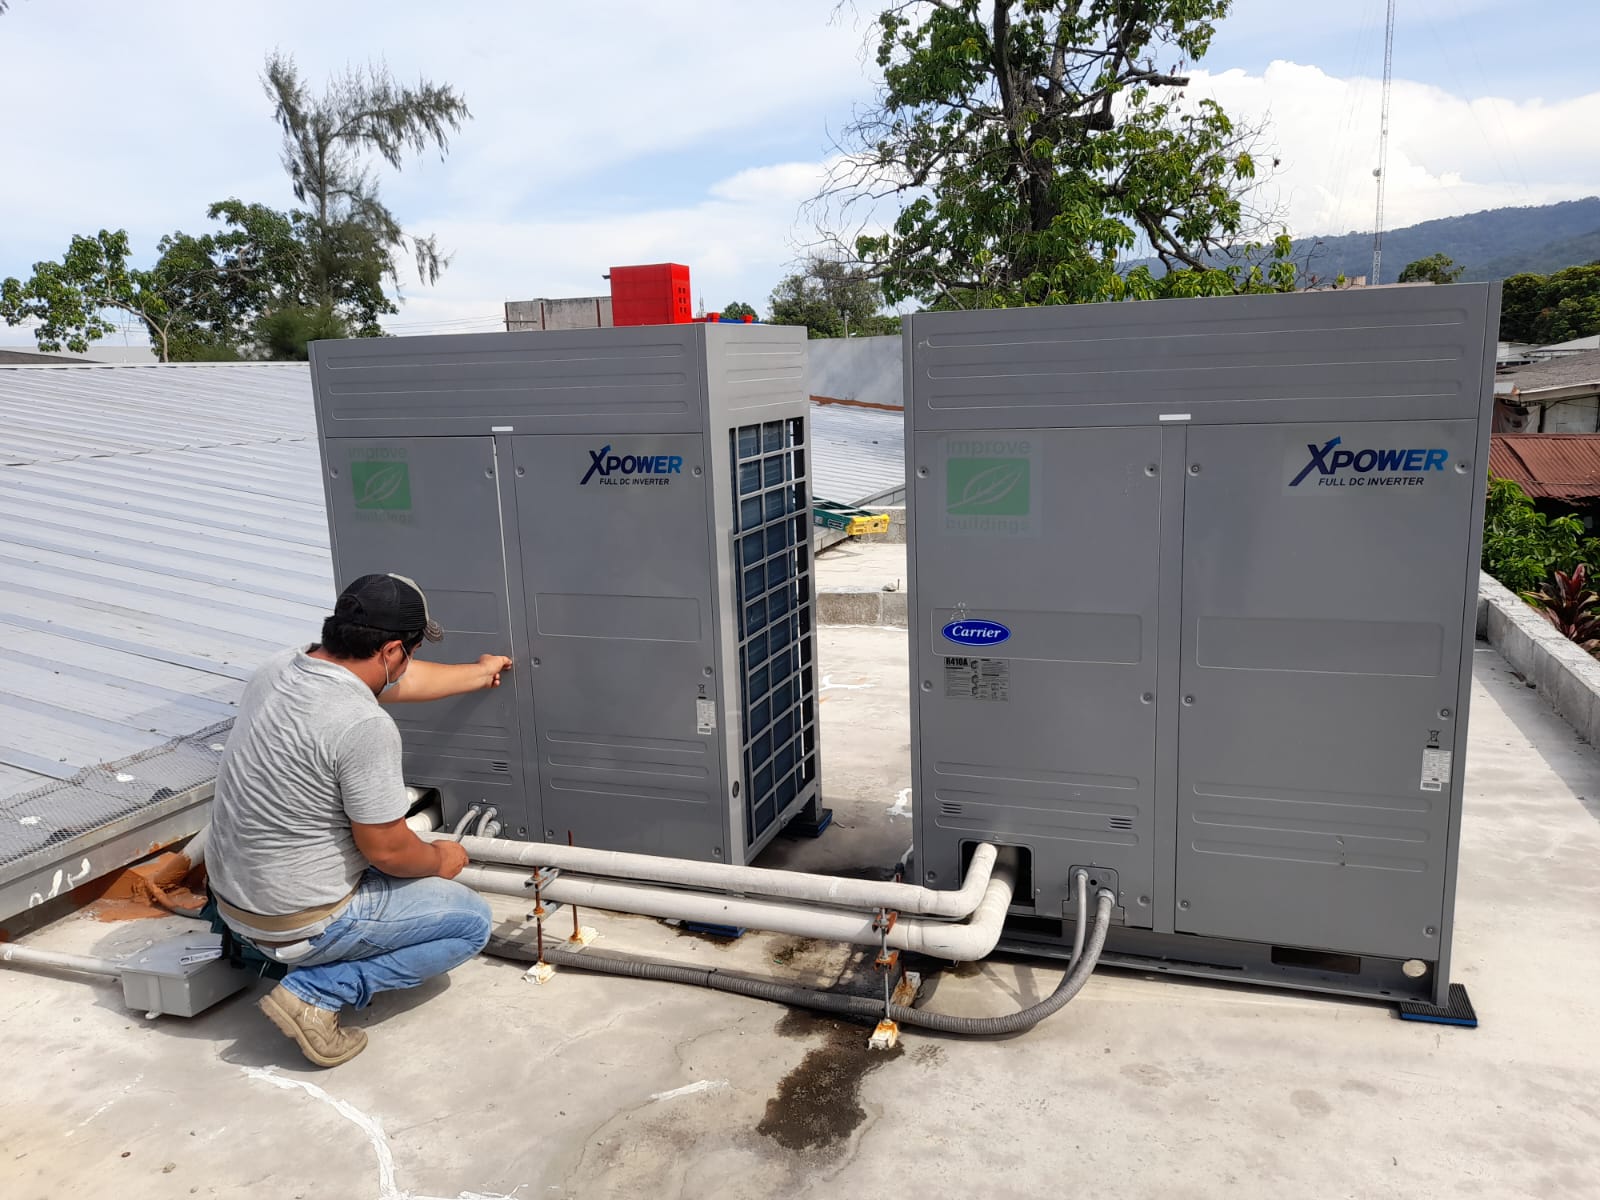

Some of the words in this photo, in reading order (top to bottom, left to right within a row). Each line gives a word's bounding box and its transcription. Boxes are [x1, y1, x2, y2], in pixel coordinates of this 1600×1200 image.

[580, 445, 683, 485] XPOWER
[1289, 436, 1449, 486] XPOWER
[599, 478, 618, 486] FULL
[619, 478, 630, 486] DC
[632, 477, 670, 486] INVERTER
[1318, 477, 1346, 486] FULL
[1349, 477, 1365, 486] DC
[1367, 476, 1425, 486] INVERTER
[952, 625, 1002, 638] Carrier
